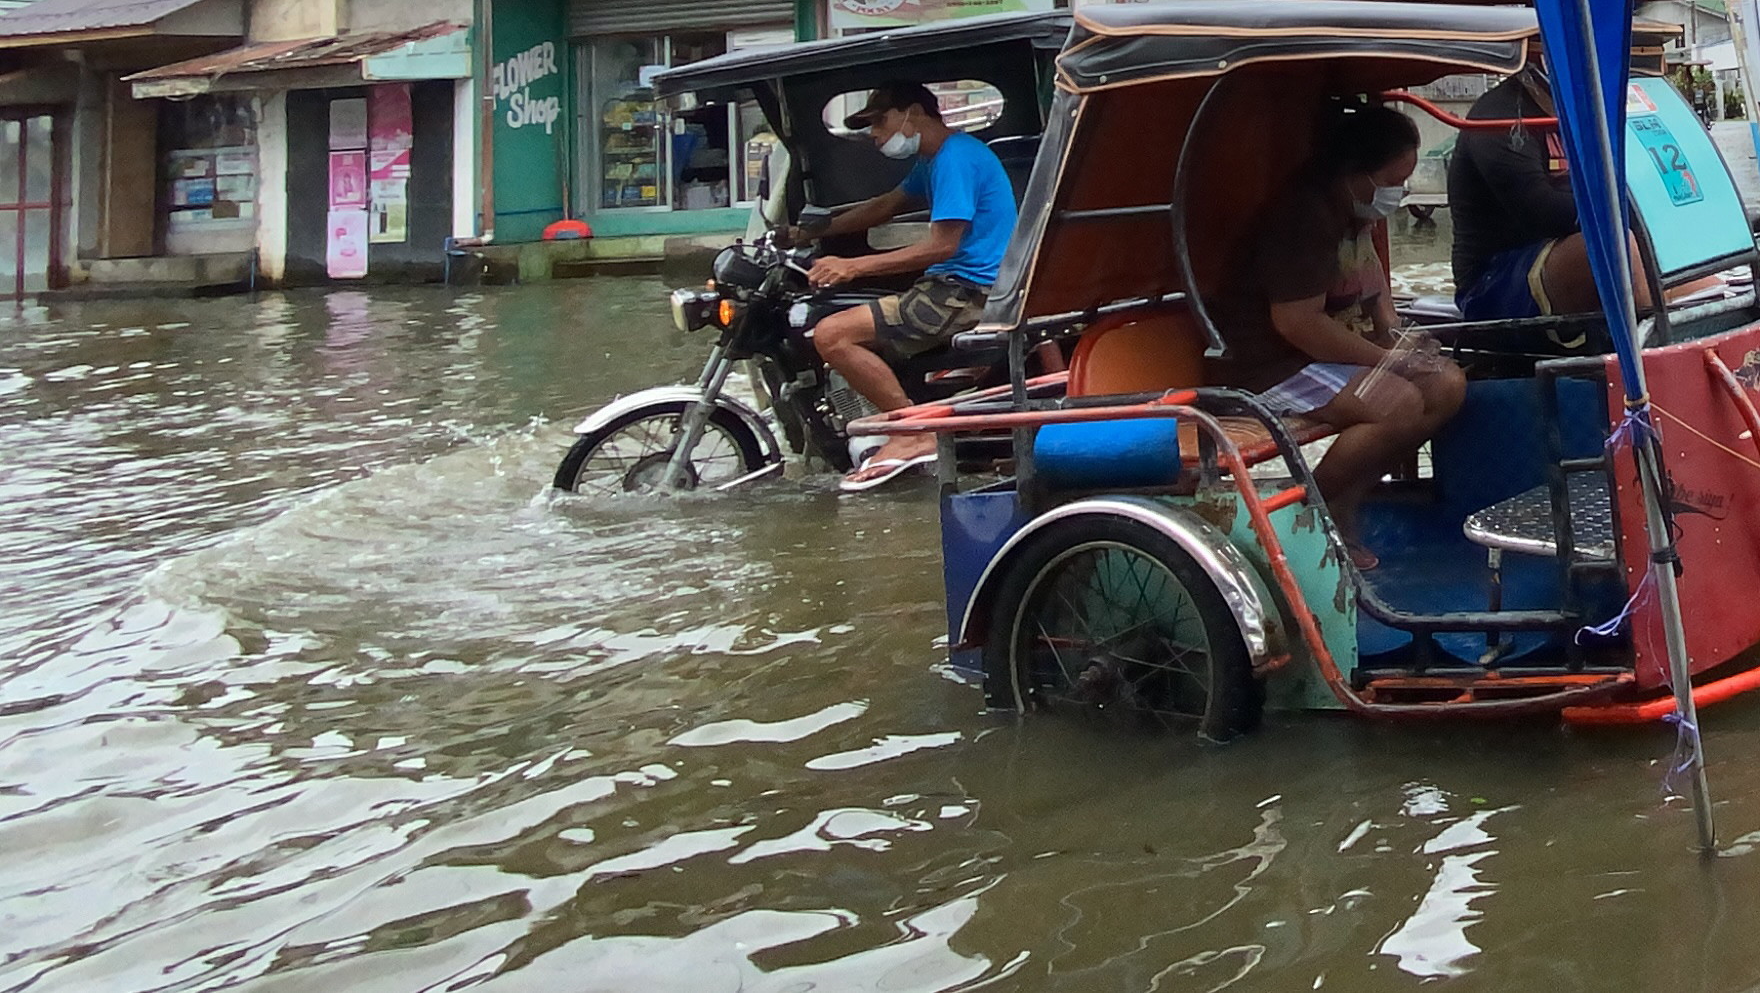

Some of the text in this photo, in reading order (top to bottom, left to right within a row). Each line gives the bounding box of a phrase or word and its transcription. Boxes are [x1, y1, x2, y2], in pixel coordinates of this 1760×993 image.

[493, 41, 558, 110] FLOWER
[507, 86, 560, 135] Shop
[1648, 144, 1687, 174] 12
